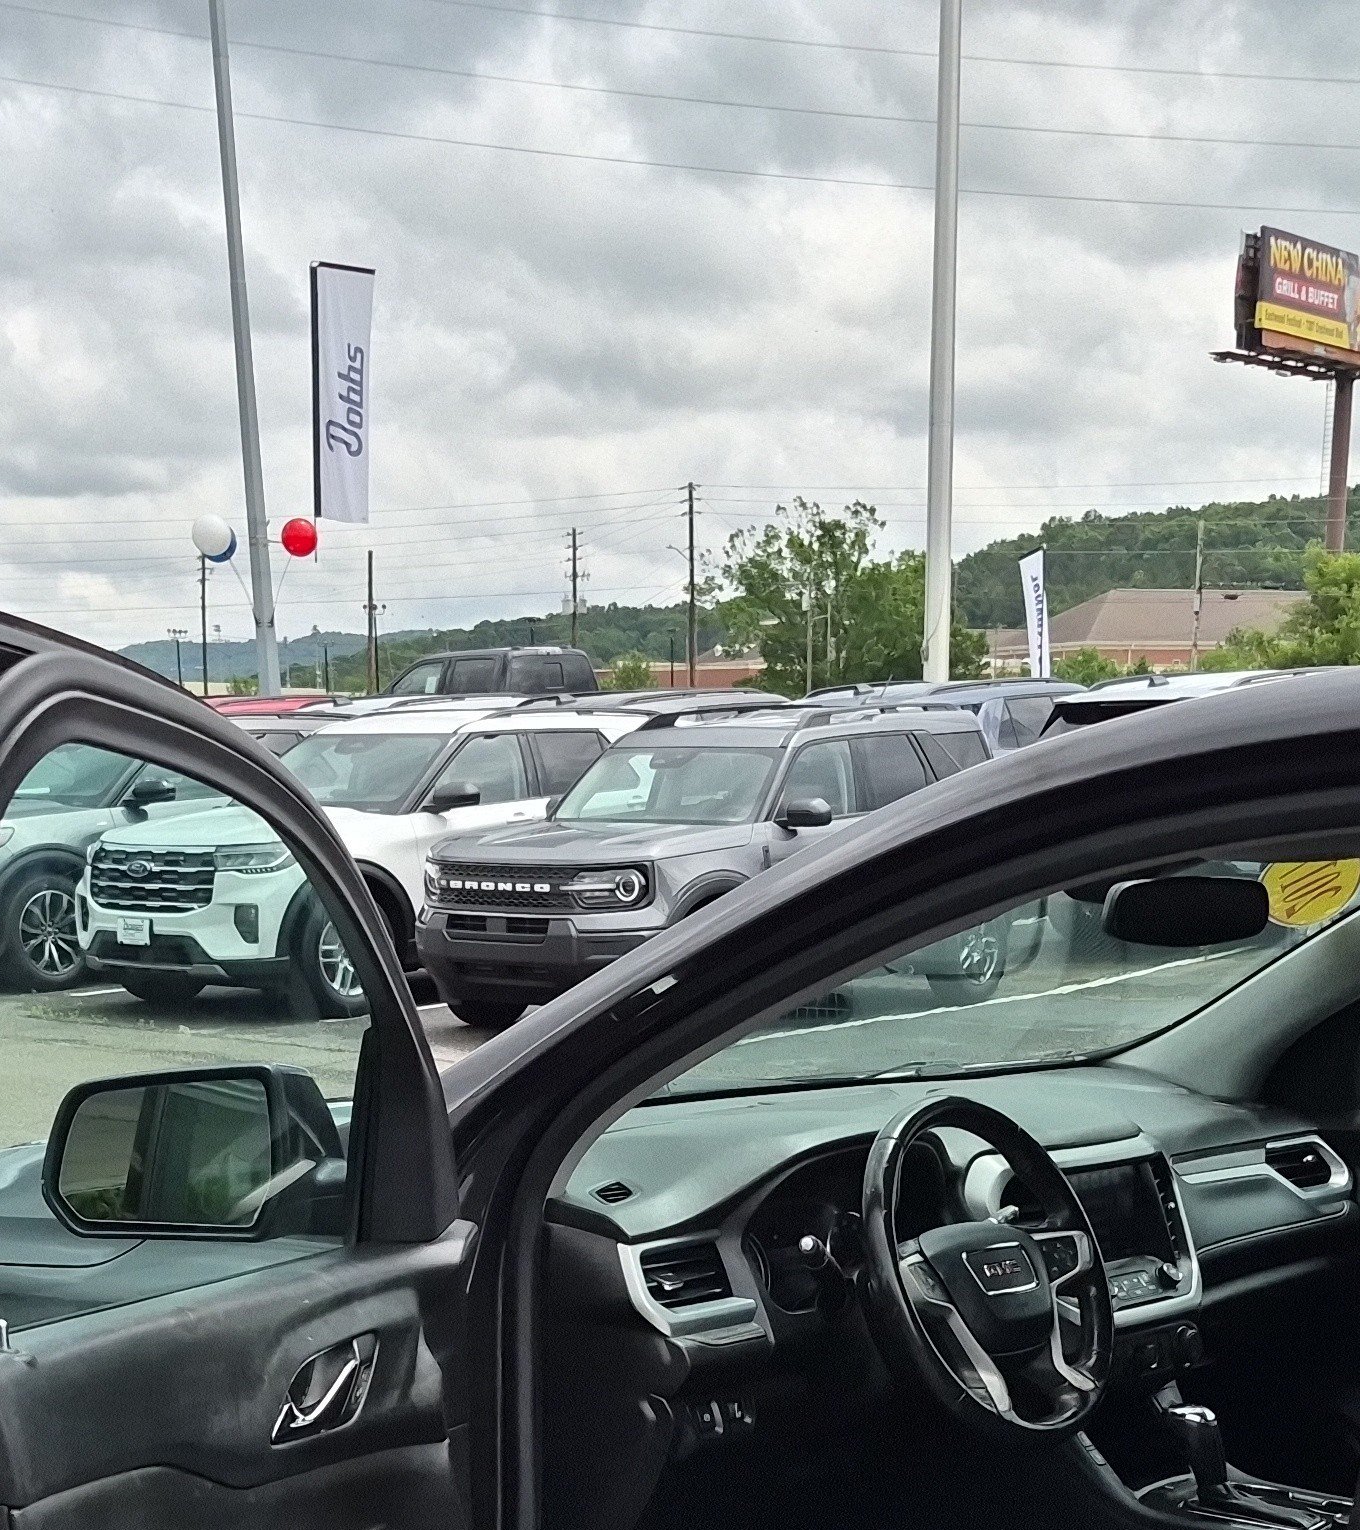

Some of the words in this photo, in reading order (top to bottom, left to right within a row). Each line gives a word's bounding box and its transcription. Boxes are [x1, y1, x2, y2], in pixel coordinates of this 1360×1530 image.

[1270, 236, 1302, 274] NEW
[1304, 247, 1344, 287] CHINA
[1275, 277, 1299, 298] GRILL
[1308, 286, 1338, 309] BUFFET
[325, 342, 365, 458] Dobbs
[448, 880, 552, 893] BRONCO
